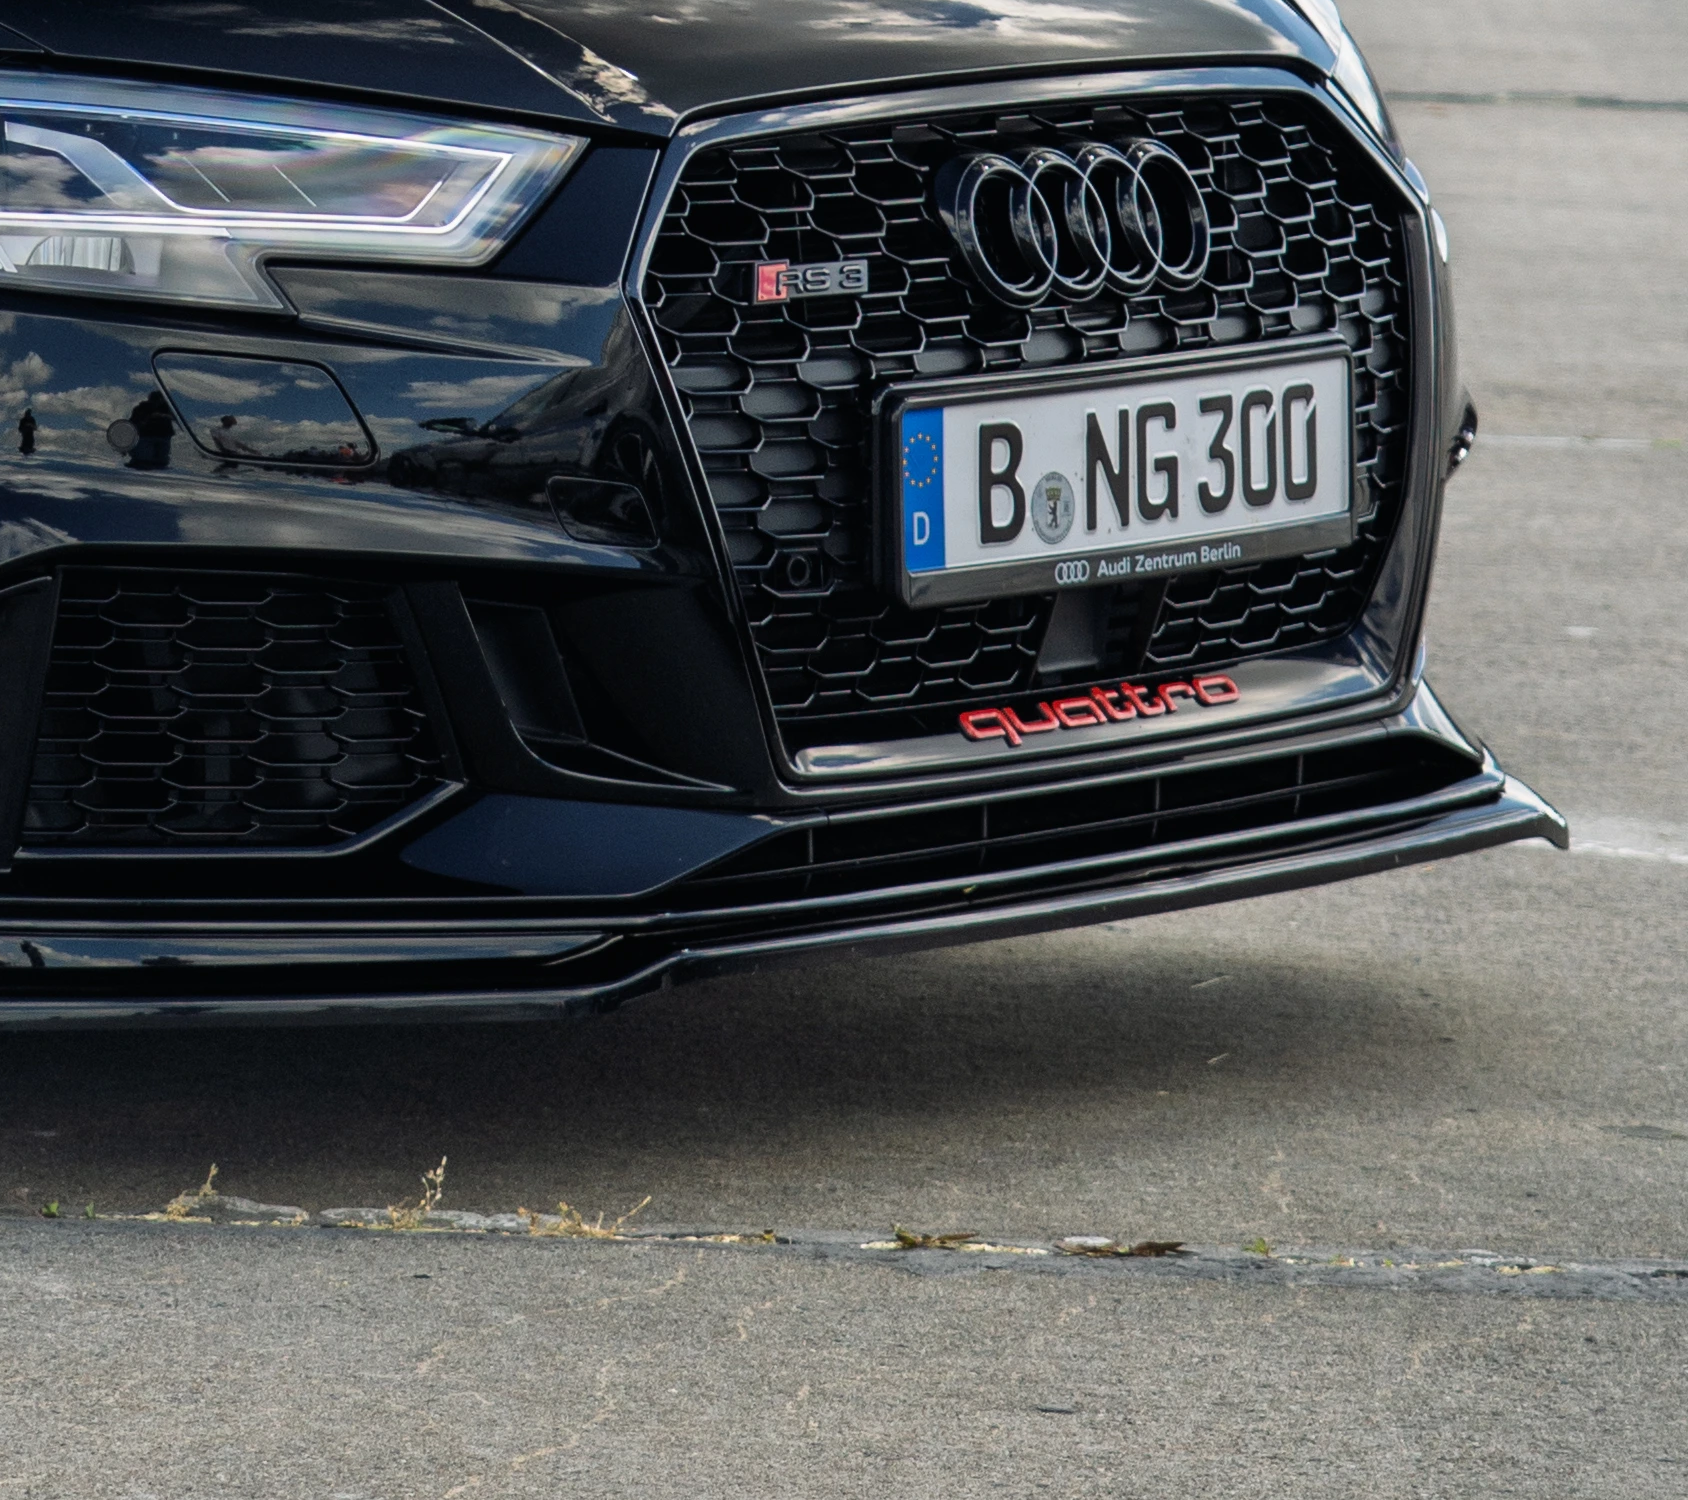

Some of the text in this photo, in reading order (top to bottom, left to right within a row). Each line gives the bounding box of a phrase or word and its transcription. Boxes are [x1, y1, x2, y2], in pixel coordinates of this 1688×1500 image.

[775, 263, 863, 296] RS 3
[978, 382, 1318, 546] B NG 300
[913, 511, 930, 545] D
[1097, 542, 1242, 578] Audi Zentrum Berlin
[959, 673, 1241, 746] quattro
